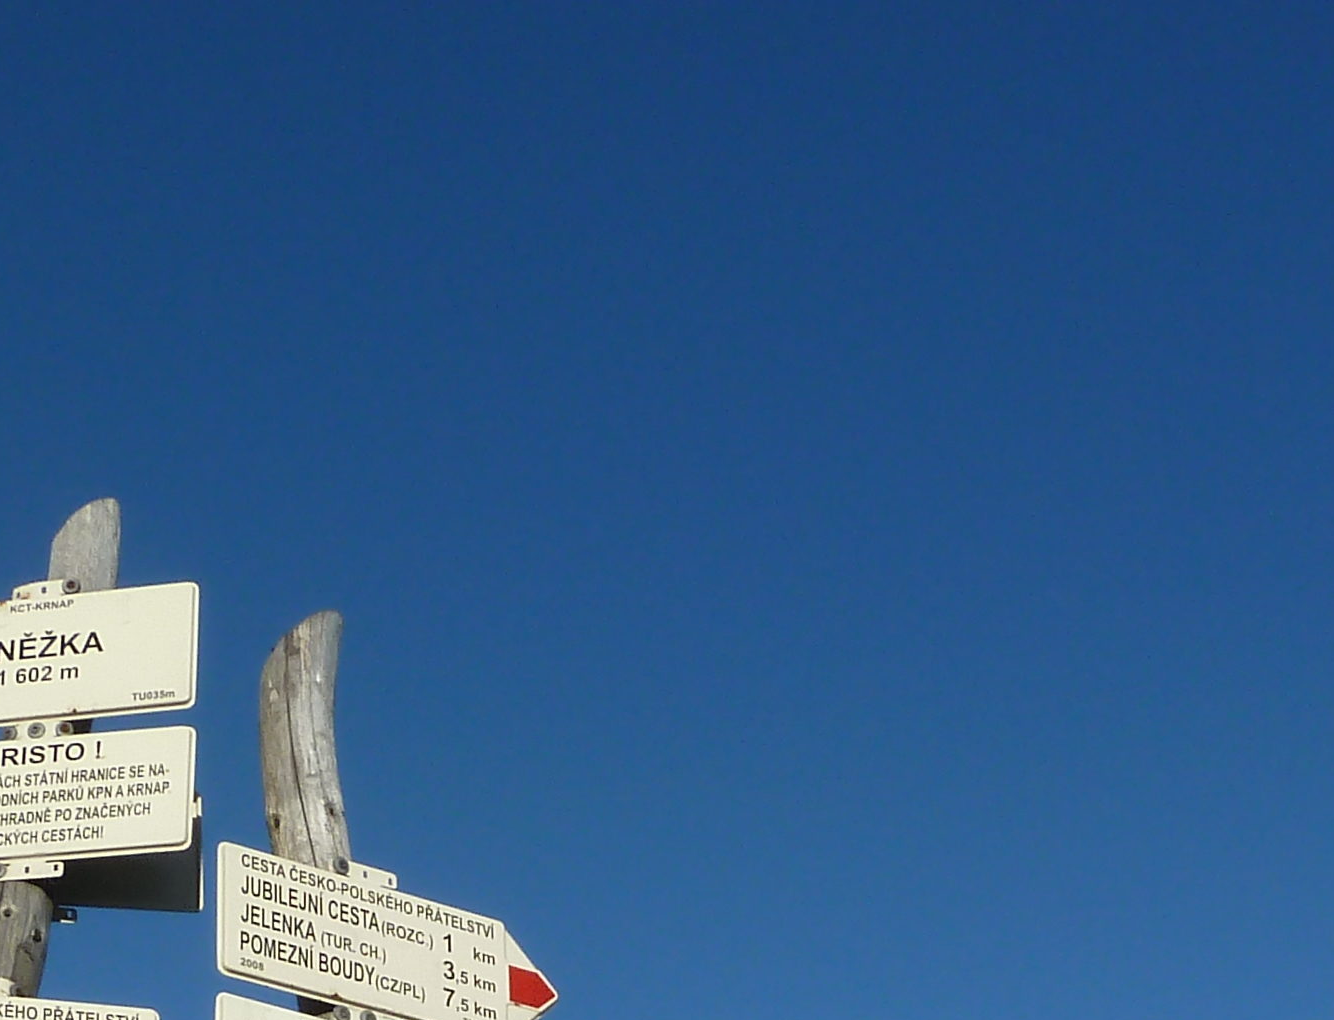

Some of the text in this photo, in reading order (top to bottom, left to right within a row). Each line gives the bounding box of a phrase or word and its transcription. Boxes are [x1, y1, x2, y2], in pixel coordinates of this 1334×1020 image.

[16, 666, 52, 684] 602
[60, 667, 79, 680] m
[132, 691, 175, 702] TU035m
[96, 741, 101, 758] !
[24, 768, 69, 787] STÁTNÍ
[72, 767, 125, 783] HRANICE
[129, 765, 144, 778] SE
[149, 764, 169, 777] NA-
[43, 786, 83, 802] PARKŮ
[88, 786, 112, 799] KPN
[115, 785, 123, 797] A
[55, 809, 71, 821] PO
[75, 801, 151, 820] ZNAČENÝCH
[42, 826, 103, 843] CESTÁCH!
[241, 854, 494, 939] CESTA ČESKO-POLSKÉHO PŘÁTELSTVÍ
[241, 875, 495, 965] JUBILEJNÍ CESTA (ROZC.) 1 km
[241, 903, 316, 941] JELENKA
[321, 932, 355, 953] (TUR.
[443, 961, 468, 984] 3,5
[474, 975, 496, 993] km
[240, 958, 264, 971] 2008
[241, 931, 496, 1020] POMEZNÍ BOUDY (CZ/PL) 7,5 km
